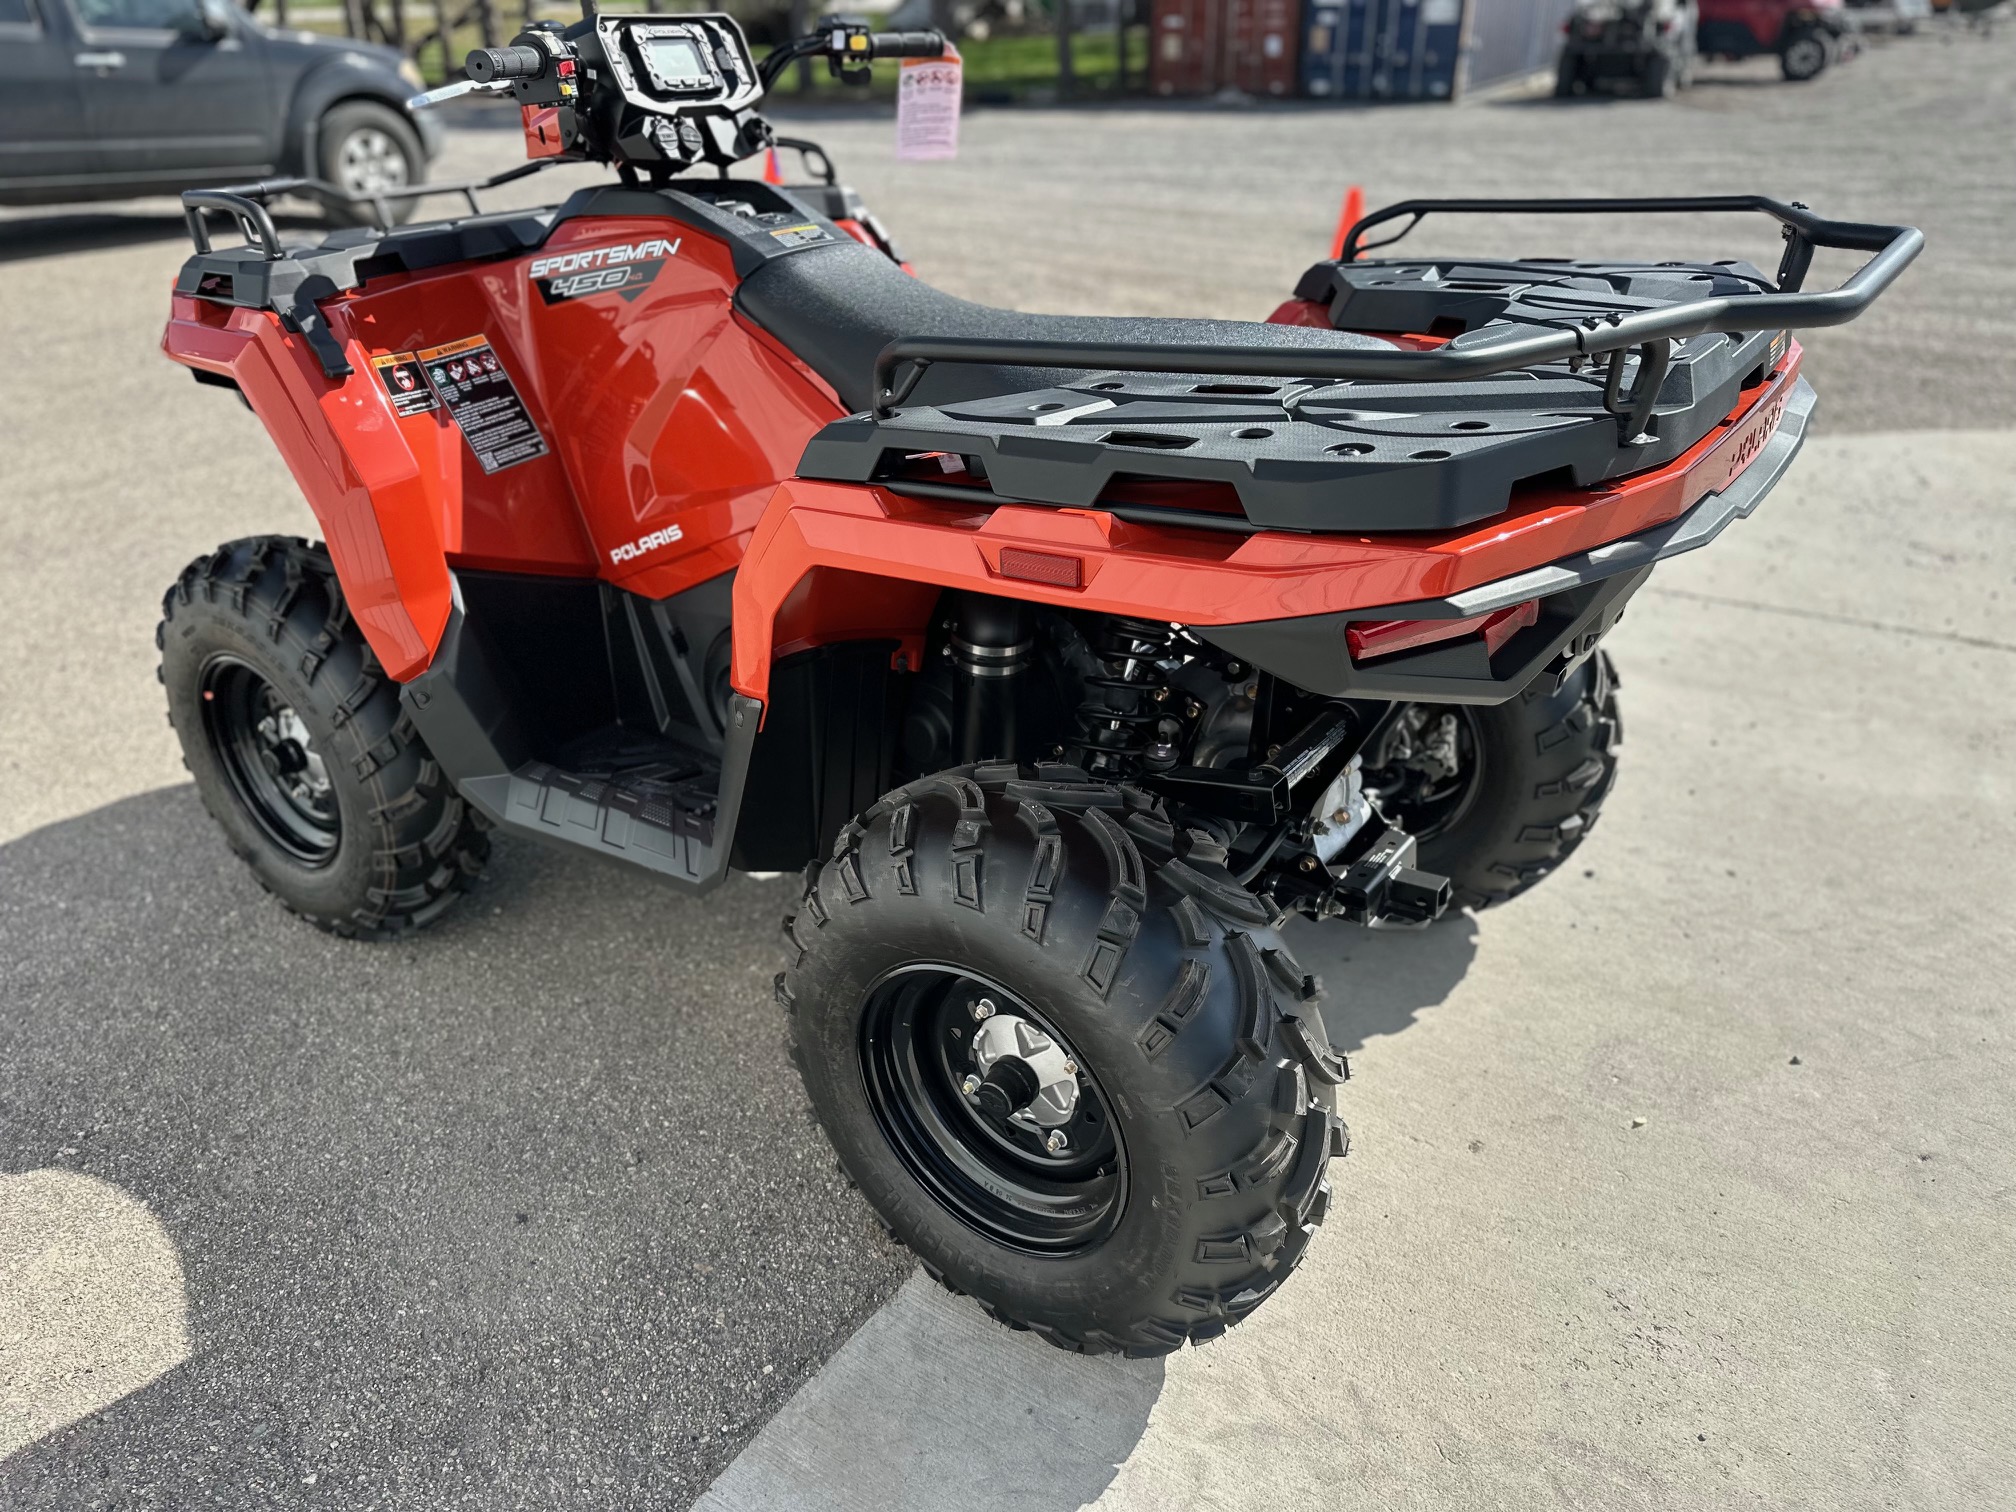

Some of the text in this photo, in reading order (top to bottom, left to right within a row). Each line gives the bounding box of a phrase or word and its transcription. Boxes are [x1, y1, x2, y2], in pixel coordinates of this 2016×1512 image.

[529, 238, 682, 279] SPORTSMAN
[550, 266, 631, 297] 450
[442, 341, 469, 355] WARNING
[610, 523, 683, 565] POLARIS
